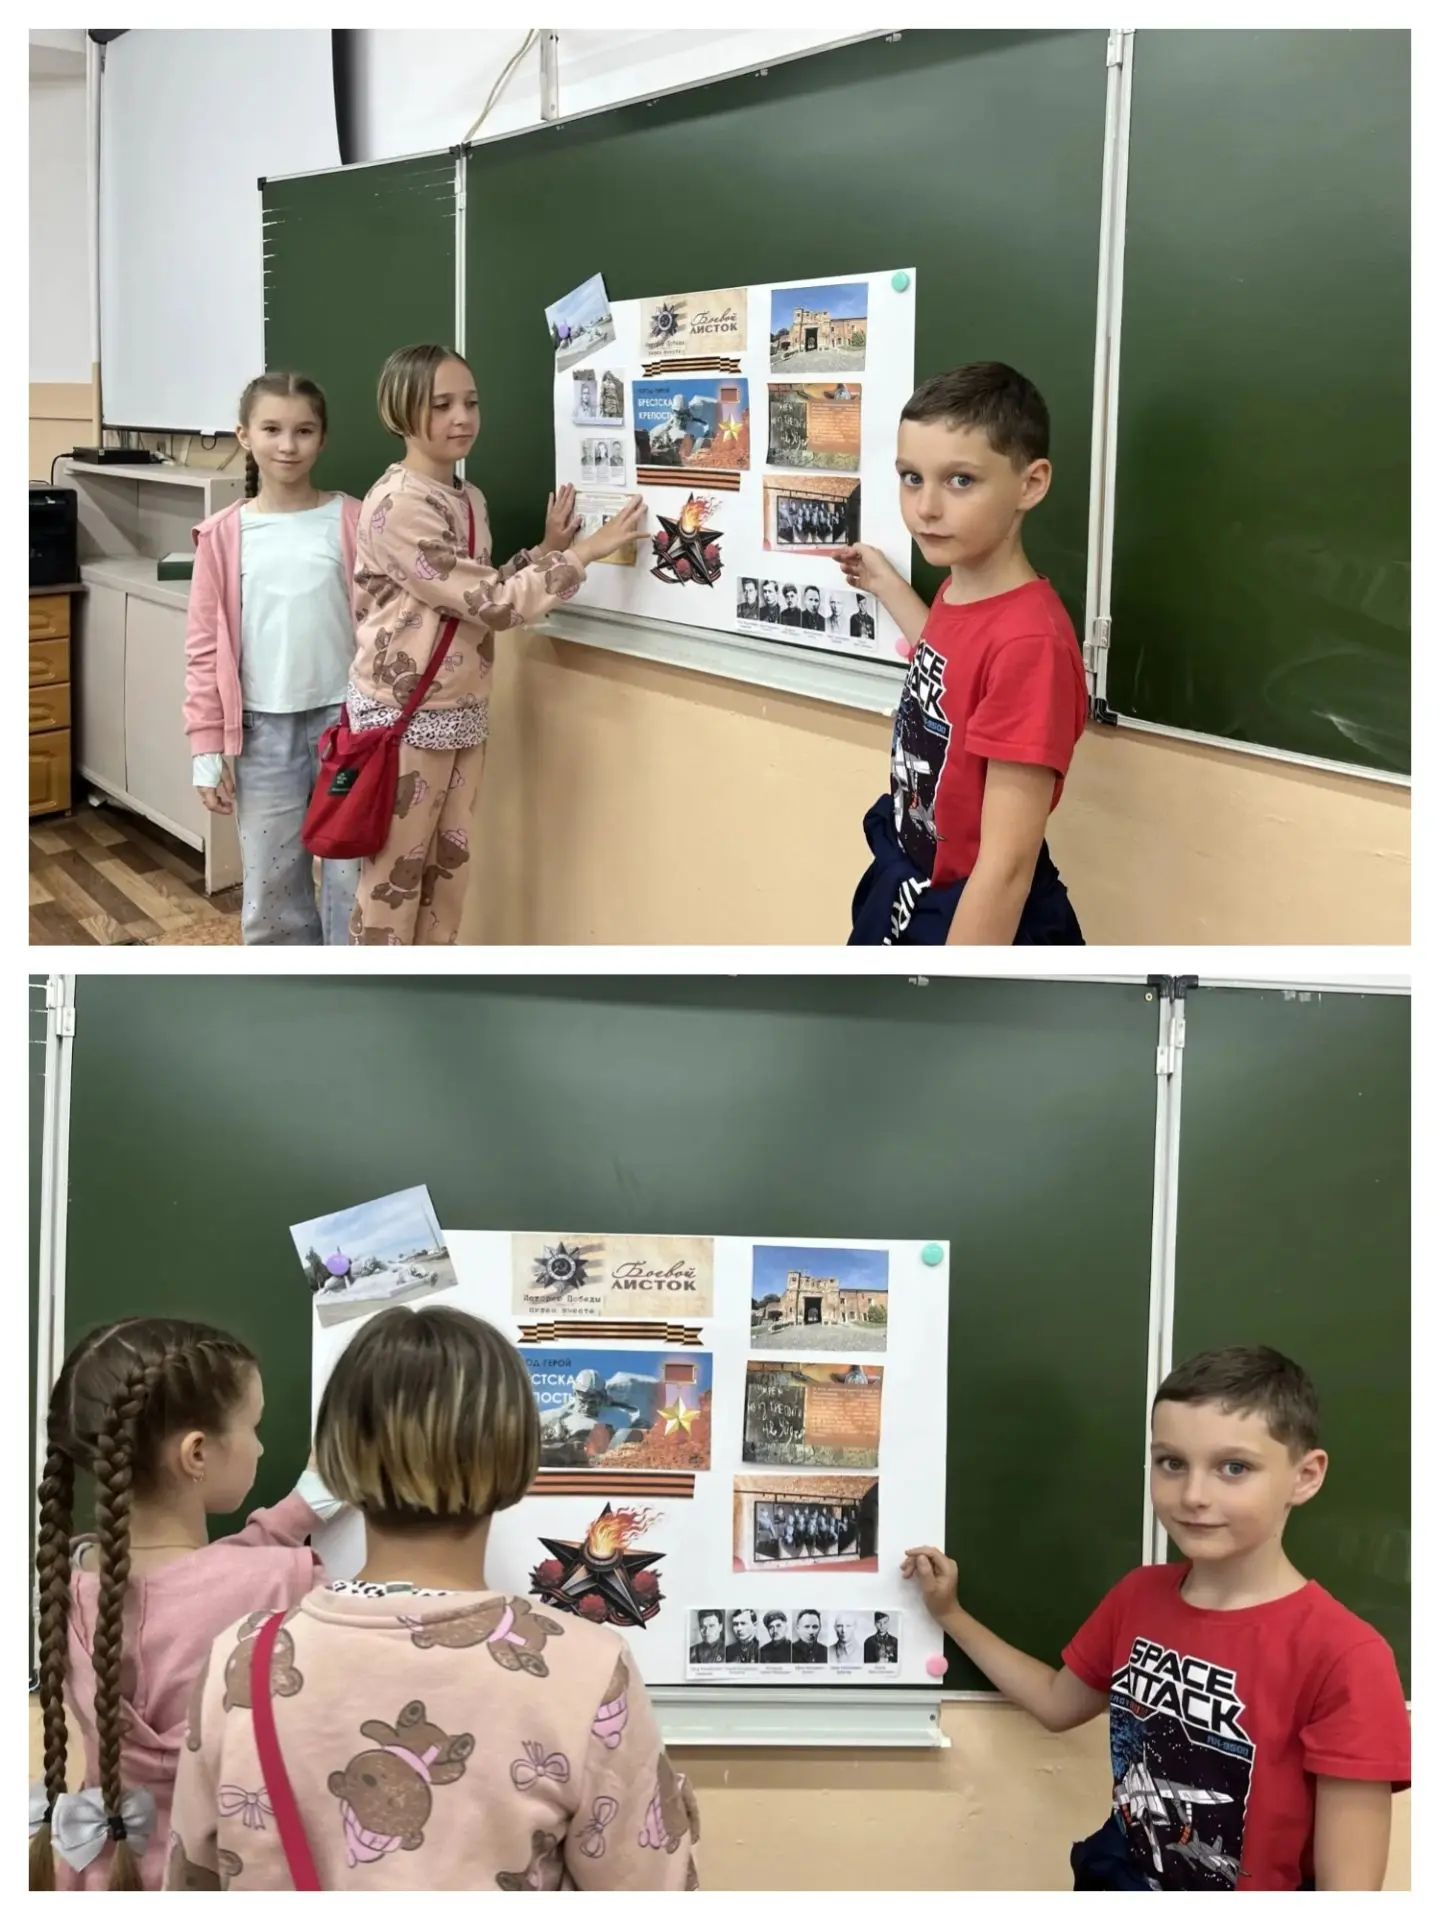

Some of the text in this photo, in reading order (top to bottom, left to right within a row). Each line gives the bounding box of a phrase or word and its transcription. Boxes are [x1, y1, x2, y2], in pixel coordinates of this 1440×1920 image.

[689, 322, 738, 334] ЛИСТОК
[637, 398, 674, 408] БРЕСТСКА
[611, 1260, 697, 1279] Боевой
[611, 1279, 697, 1291] ЛИСТОК
[543, 1357, 572, 1368] ГЕРОЙ
[1130, 1639, 1234, 1700] SPACE
[1112, 1666, 1250, 1742] ATTACK
